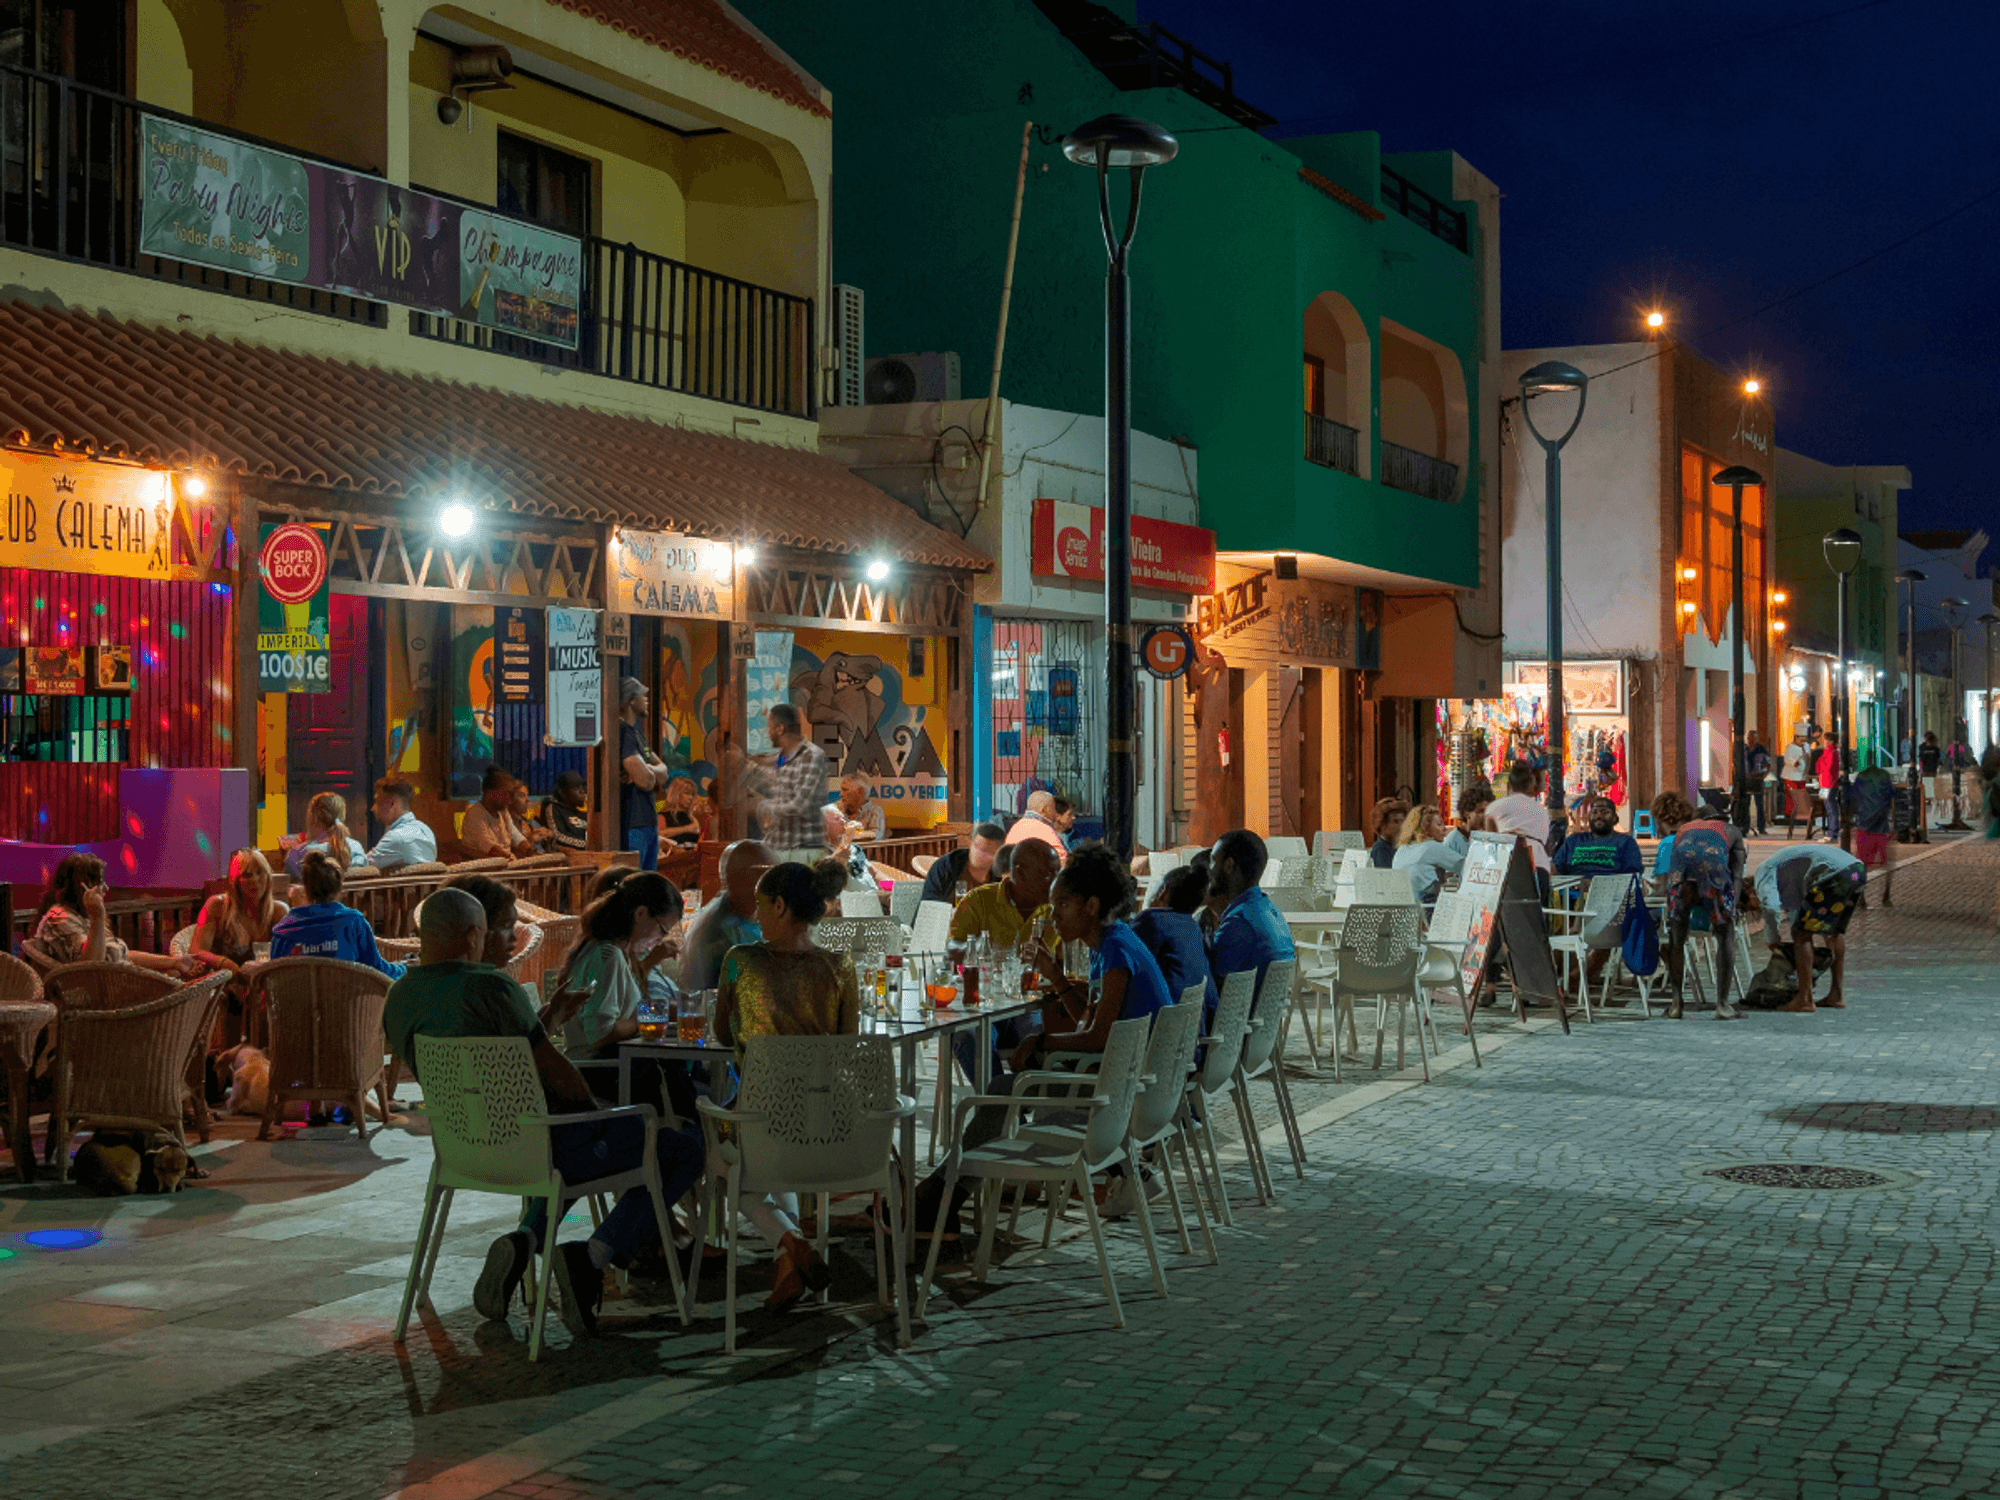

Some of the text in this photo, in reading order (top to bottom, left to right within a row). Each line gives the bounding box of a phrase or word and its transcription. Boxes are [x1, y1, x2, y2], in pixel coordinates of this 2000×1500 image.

[151, 133, 228, 177] Every Friday
[151, 157, 304, 239] Party Nights
[173, 220, 209, 247] Todas
[211, 236, 227, 250] as
[374, 225, 411, 281] VIP
[0, 493, 147, 554] UB CALEMA
[1066, 532, 1087, 555] Image
[1131, 535, 1162, 563] Vieira
[273, 550, 313, 564] SUPER
[1065, 549, 1089, 568] Service
[274, 564, 311, 578] BOCK
[260, 634, 317, 648] IMPERIAL
[605, 635, 628, 651] WIFI
[560, 647, 601, 669] MUSIC
[868, 784, 905, 799] ABO
